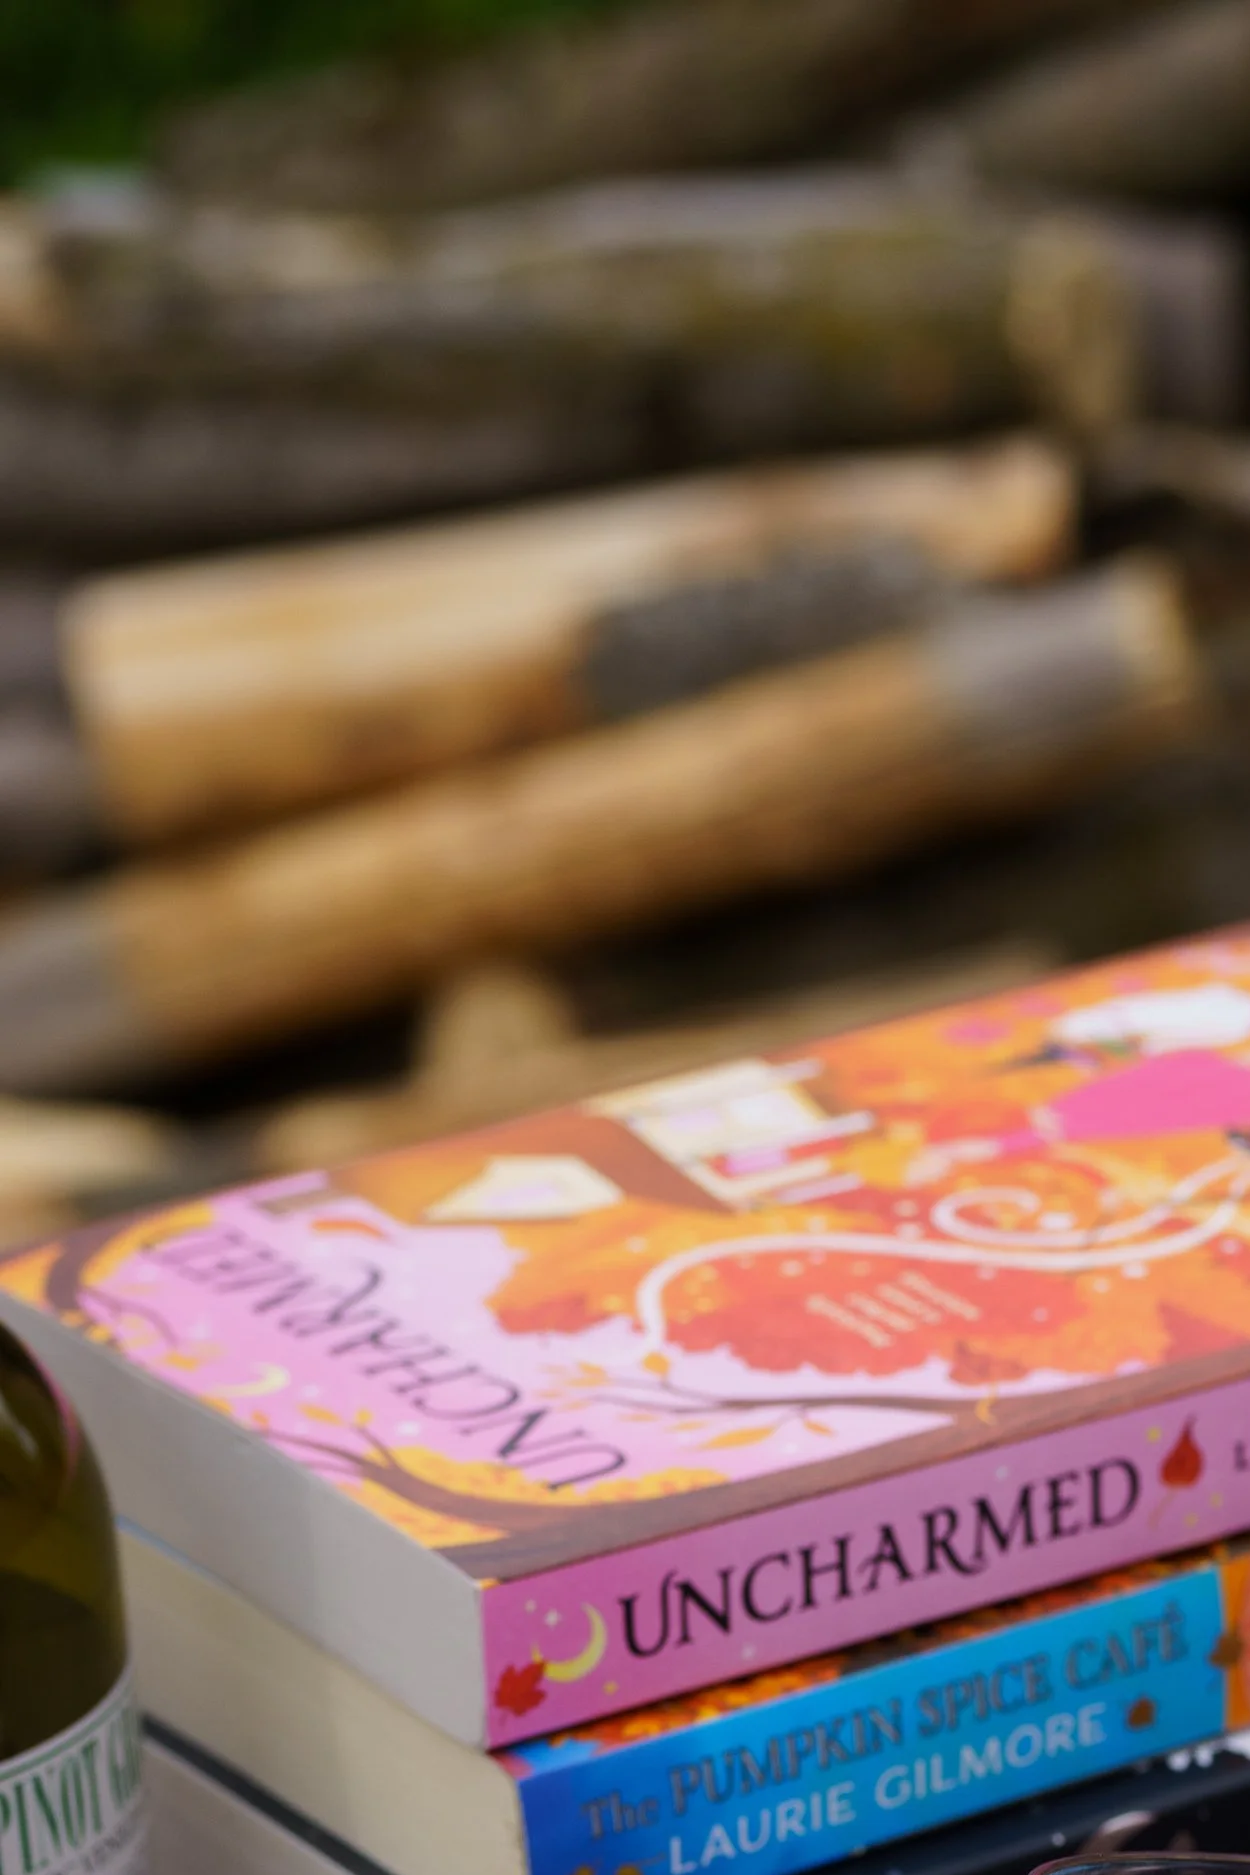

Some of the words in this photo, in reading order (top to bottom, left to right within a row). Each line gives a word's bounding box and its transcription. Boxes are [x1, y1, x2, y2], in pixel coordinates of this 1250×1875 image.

[618, 1456, 1143, 1658] UNCHARMED
[580, 1788, 660, 1840] The
[669, 1697, 905, 1815] PUMPKIN
[918, 1650, 1053, 1741] SPICE
[1062, 1600, 1188, 1700] CAFÉ
[872, 1703, 1107, 1811] GILMORE
